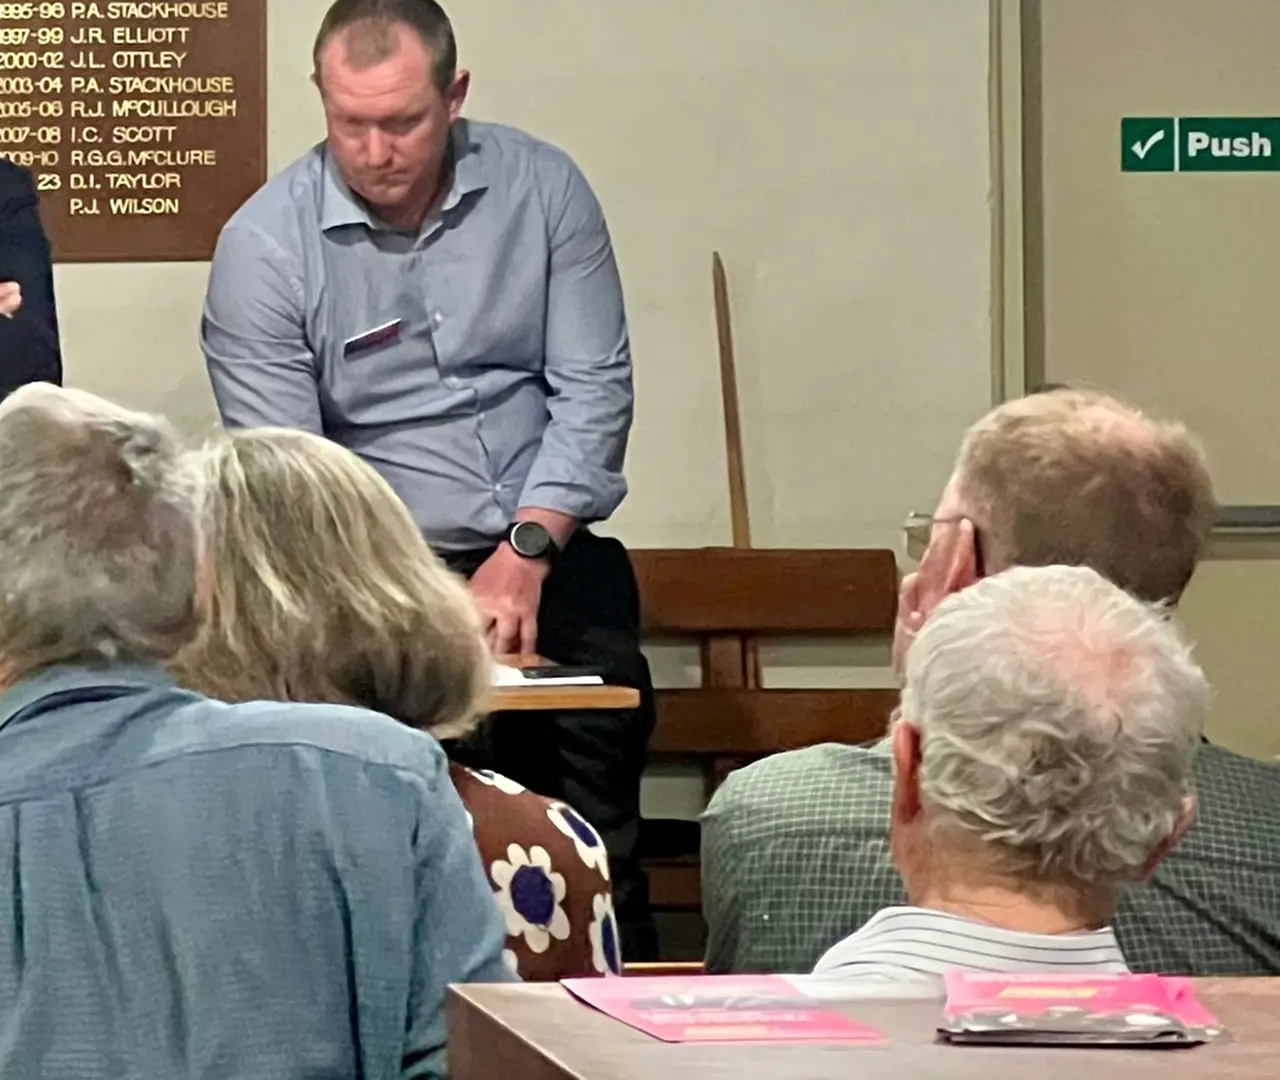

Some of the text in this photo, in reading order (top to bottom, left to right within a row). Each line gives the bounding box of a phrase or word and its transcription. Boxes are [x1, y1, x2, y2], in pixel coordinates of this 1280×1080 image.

[106, 1, 229, 20] STACKHOUSE
[112, 26, 191, 46] ELLIOTT
[111, 50, 188, 70] OTTLEY
[107, 76, 235, 95] STACKHOUSE
[111, 125, 178, 145] SCOTT
[1187, 131, 1272, 158] Push
[104, 172, 182, 191] TAYLOR
[109, 197, 180, 215] WILSON
